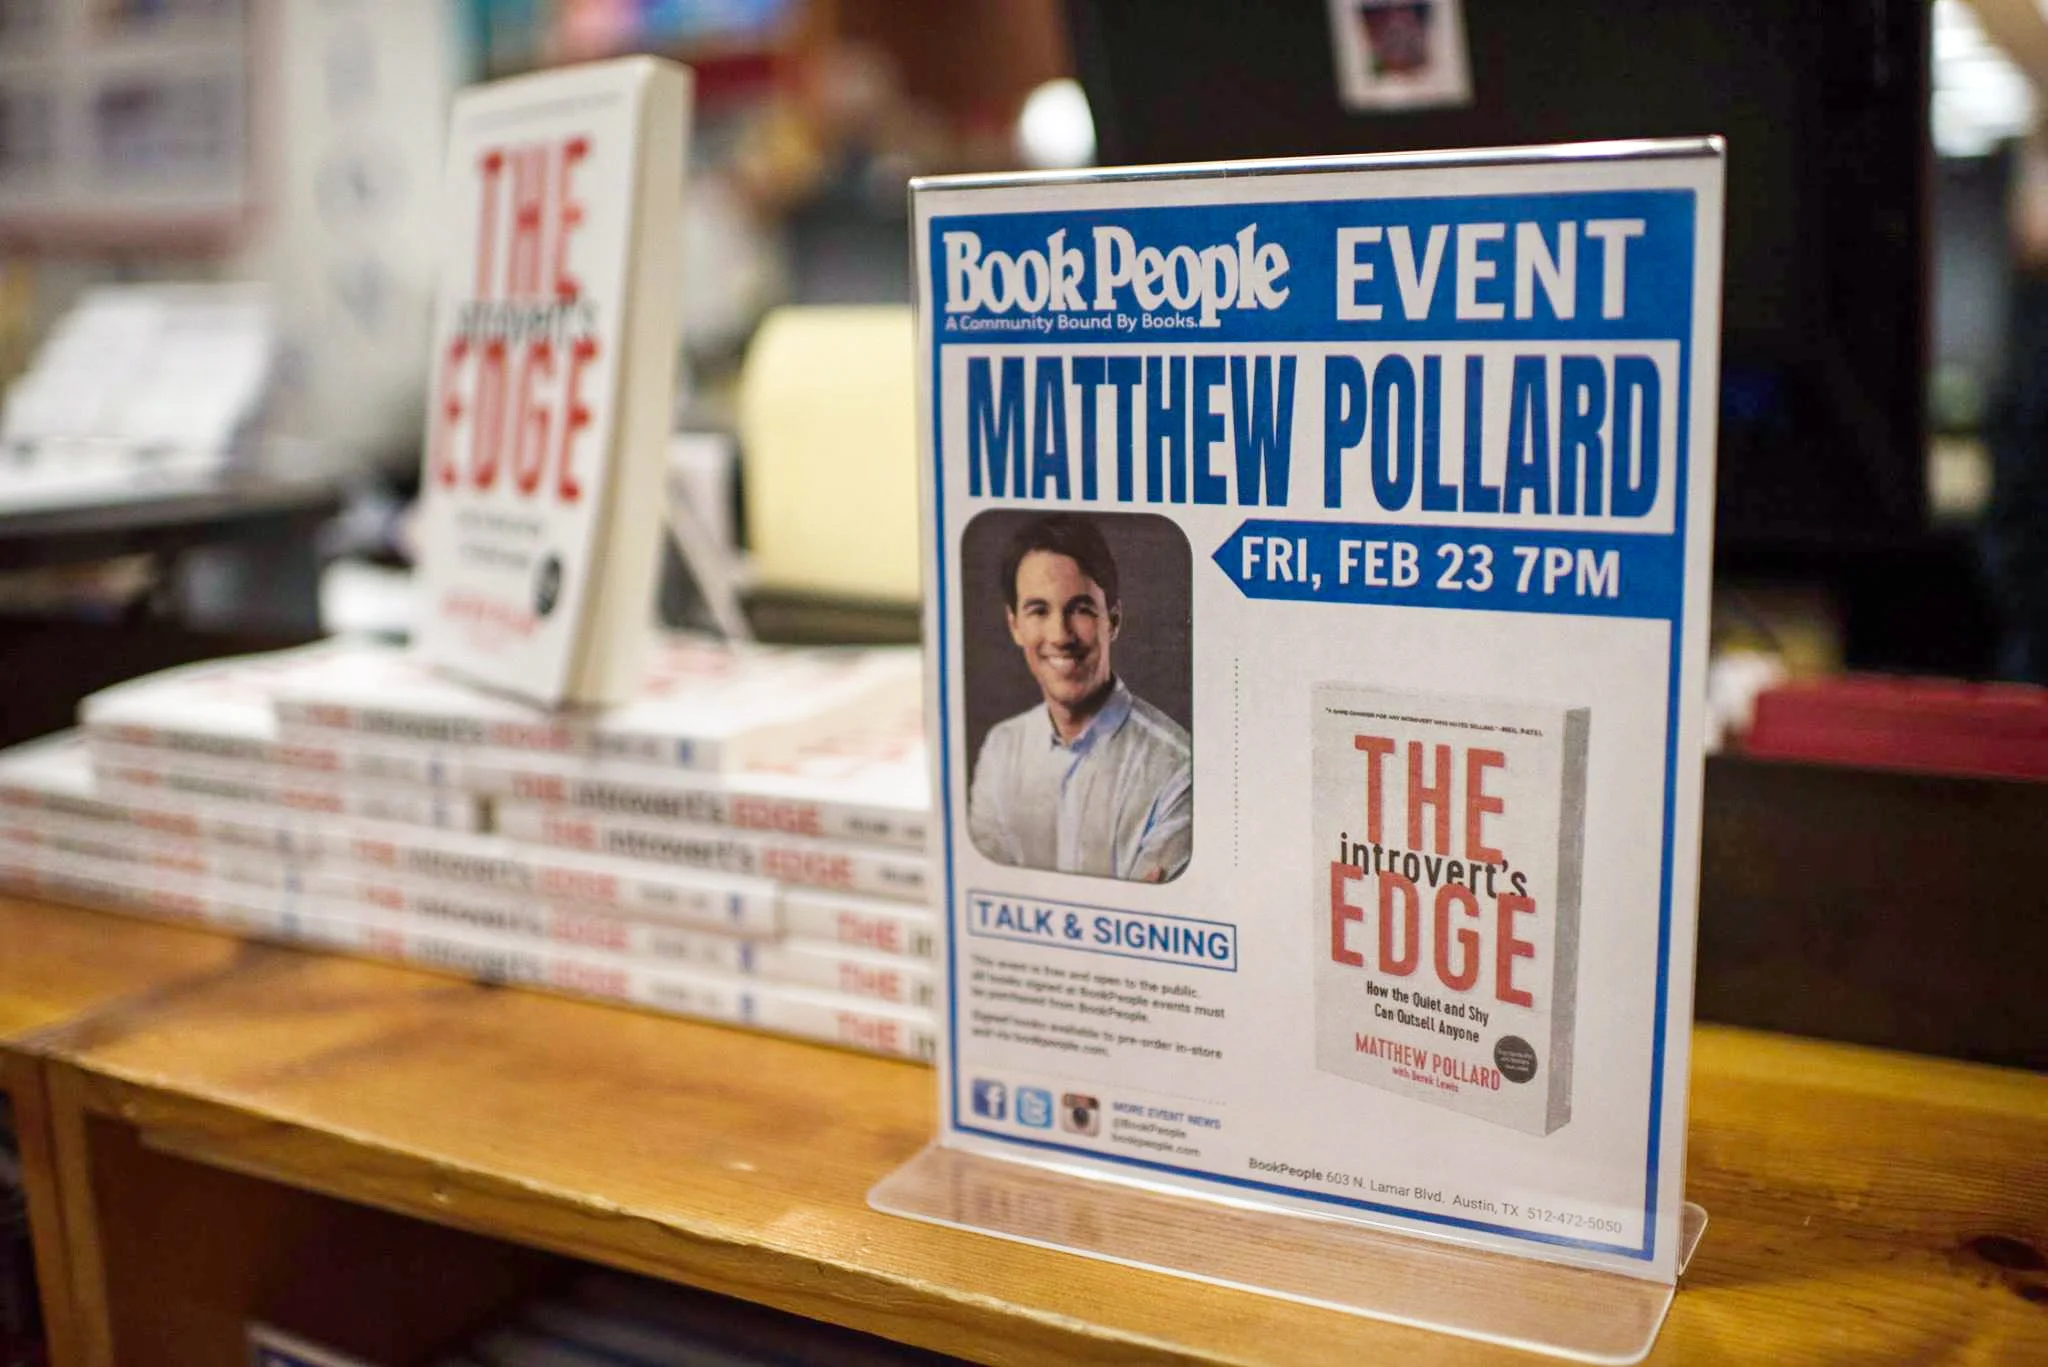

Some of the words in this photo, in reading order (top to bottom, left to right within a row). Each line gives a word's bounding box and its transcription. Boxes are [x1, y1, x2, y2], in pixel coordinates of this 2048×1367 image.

[478, 132, 594, 302] THE
[1336, 219, 1645, 322] EVENT
[945, 316, 957, 331] A
[961, 314, 1053, 332] Community
[1058, 315, 1111, 330] Bound
[1117, 315, 1137, 332] By
[1142, 314, 1198, 329] Books.
[437, 333, 602, 503] EDGE
[967, 354, 1297, 506] MATTHEW
[1323, 353, 1661, 518] POLLARD
[1242, 535, 1320, 590] FRI,
[1339, 539, 1420, 588] FEB
[1436, 542, 1494, 592] 23
[1512, 546, 1621, 598] 7PM
[1354, 734, 1505, 866] THE
[1339, 832, 1528, 900] introvert's
[976, 900, 1054, 937] TALK
[1062, 912, 1084, 941] &
[1093, 916, 1230, 962] SIGNING
[1330, 860, 1537, 1009] EDGE
[1124, 978, 1137, 989] to
[1139, 980, 1159, 993] the
[1151, 998, 1191, 1014] events
[1194, 1004, 1225, 1018] must
[1366, 980, 1389, 999] How
[1392, 987, 1409, 1005] the
[1413, 992, 1441, 1013] Quiet
[1444, 1000, 1465, 1019] and
[1469, 1005, 1490, 1028] Shy
[1175, 1042, 1223, 1060] in-store
[1374, 1003, 1394, 1021] Can
[1397, 1010, 1435, 1032] Outsell
[1438, 1020, 1481, 1043] Anyone
[1355, 1031, 1428, 1071] MATTHEW
[1432, 1053, 1501, 1092] POLLARD
[1187, 1114, 1222, 1131] NEWS
[1248, 1157, 1323, 1182] BookPeople
[1326, 1171, 1350, 1186] 603
[1352, 1176, 1367, 1190] N.
[1370, 1179, 1411, 1198] Lamar
[1413, 1187, 1446, 1204] Blvd.
[1452, 1194, 1498, 1215] Austin,
[1501, 1202, 1520, 1217] TX
[1527, 1206, 1623, 1235] 512-472-5050
